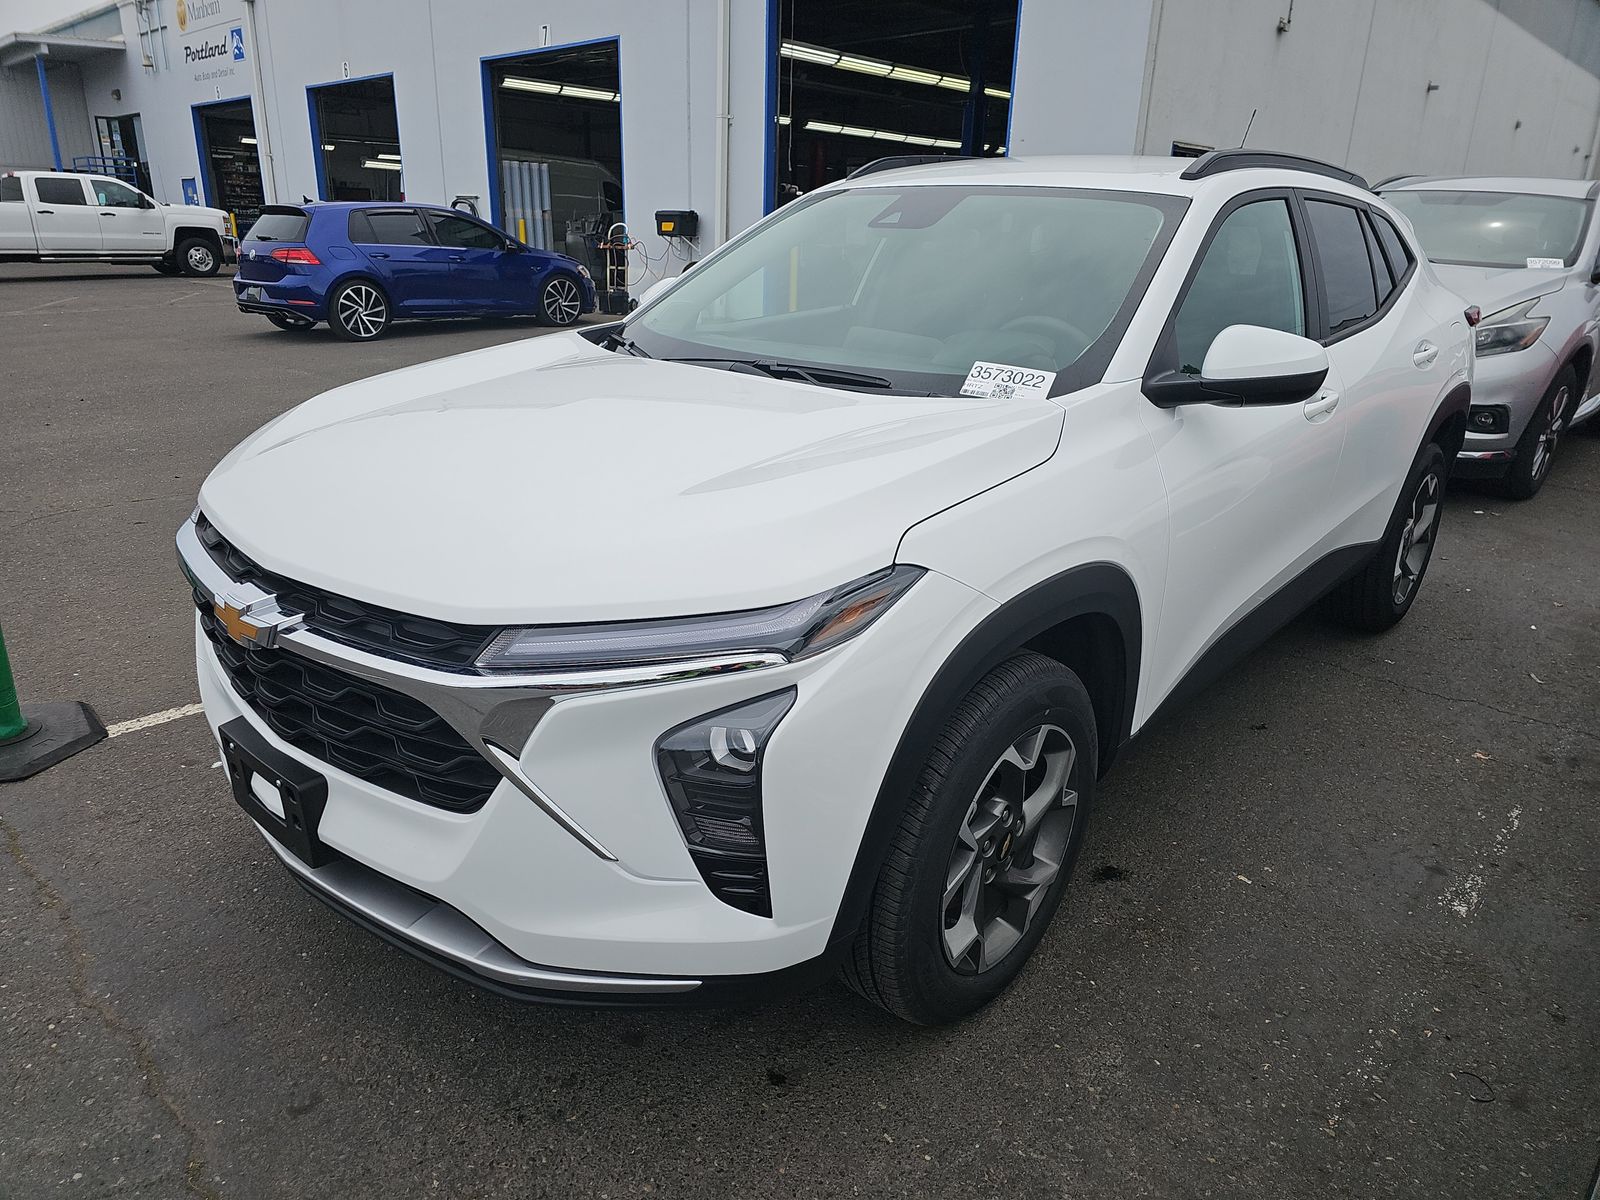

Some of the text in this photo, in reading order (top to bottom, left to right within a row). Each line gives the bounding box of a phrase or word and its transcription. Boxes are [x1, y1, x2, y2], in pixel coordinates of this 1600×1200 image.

[542, 25, 548, 46] 7
[184, 35, 228, 64] Portland
[343, 62, 349, 78] 6
[971, 365, 1045, 389] 3573022
